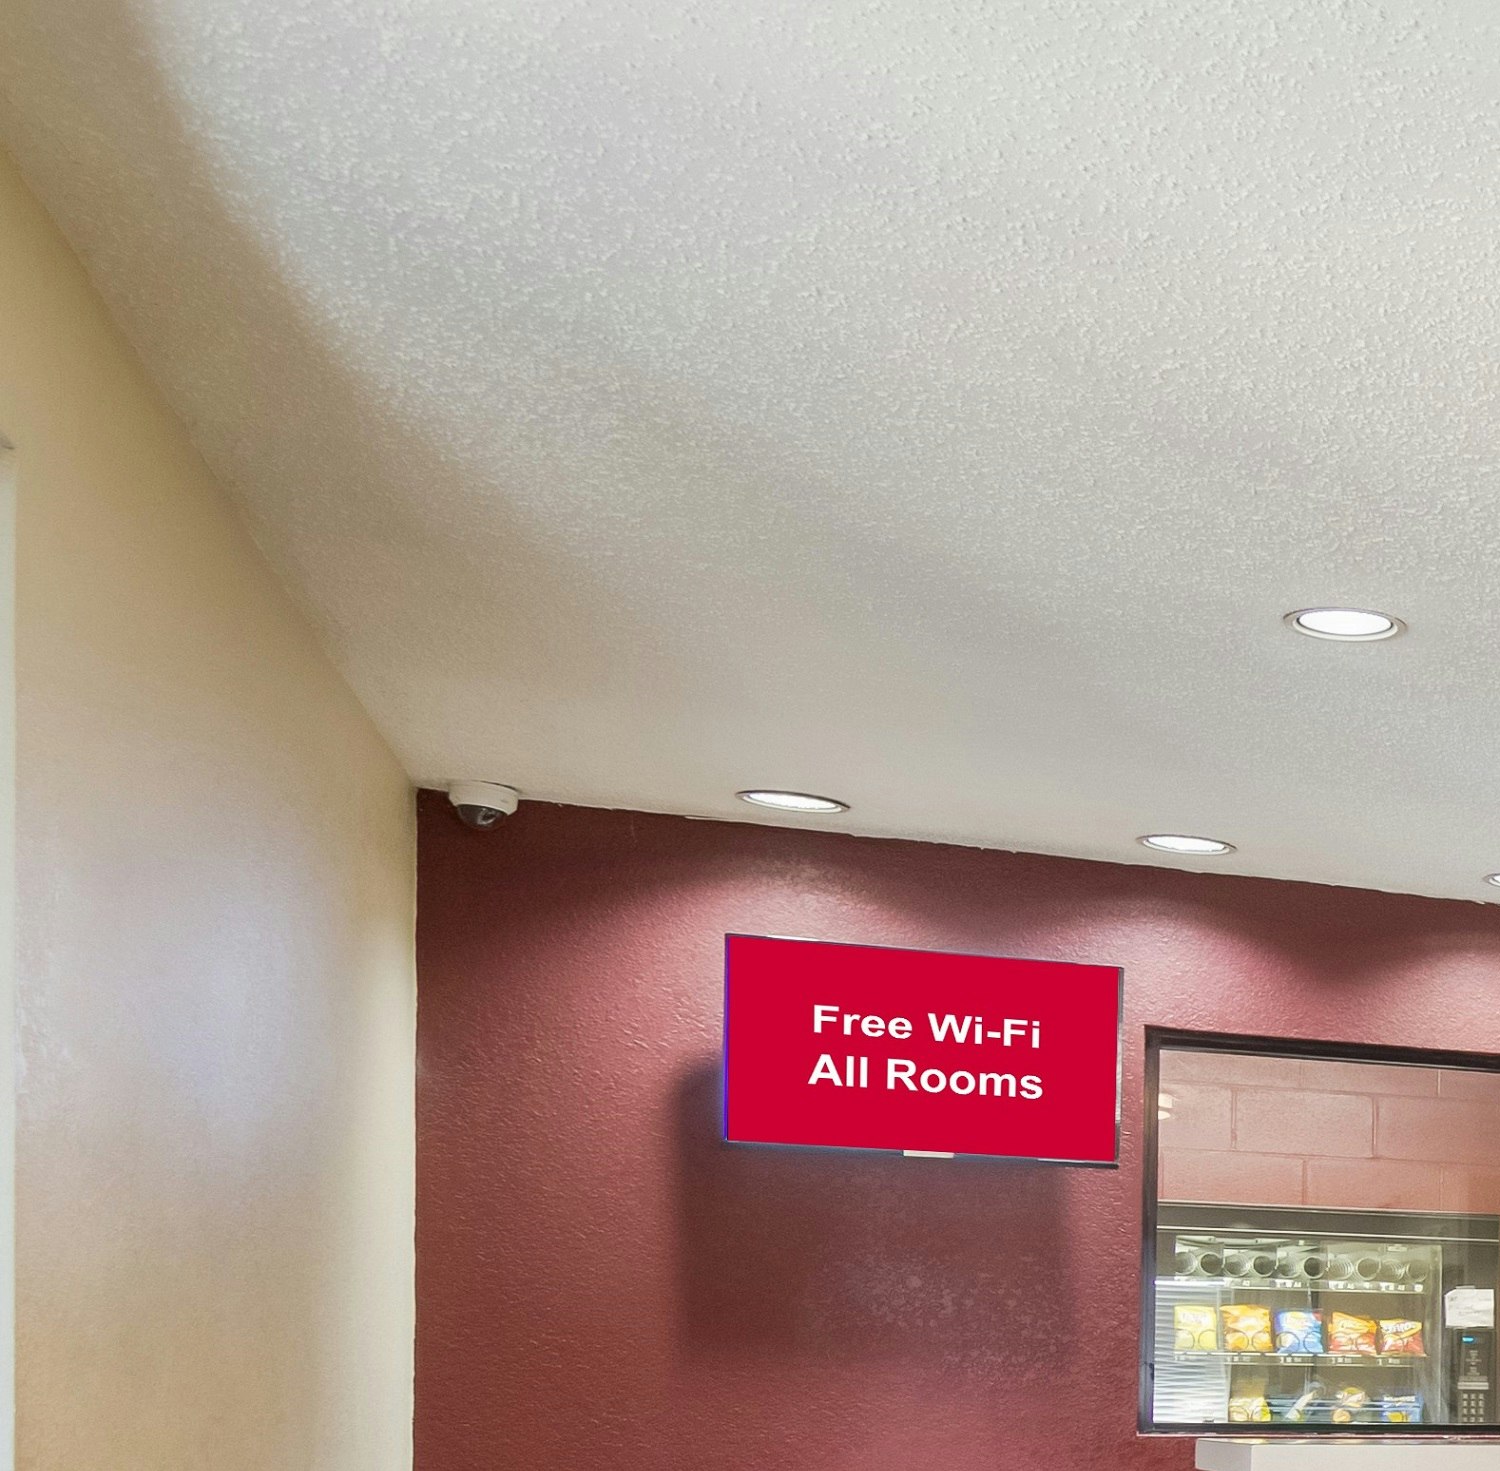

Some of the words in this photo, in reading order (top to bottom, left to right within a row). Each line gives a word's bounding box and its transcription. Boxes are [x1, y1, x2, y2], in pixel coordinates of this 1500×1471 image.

[814, 1005, 912, 1039] Free
[928, 1013, 1039, 1048] Wi-Fi
[808, 1054, 867, 1087] All
[887, 1059, 1042, 1099] Rooms
